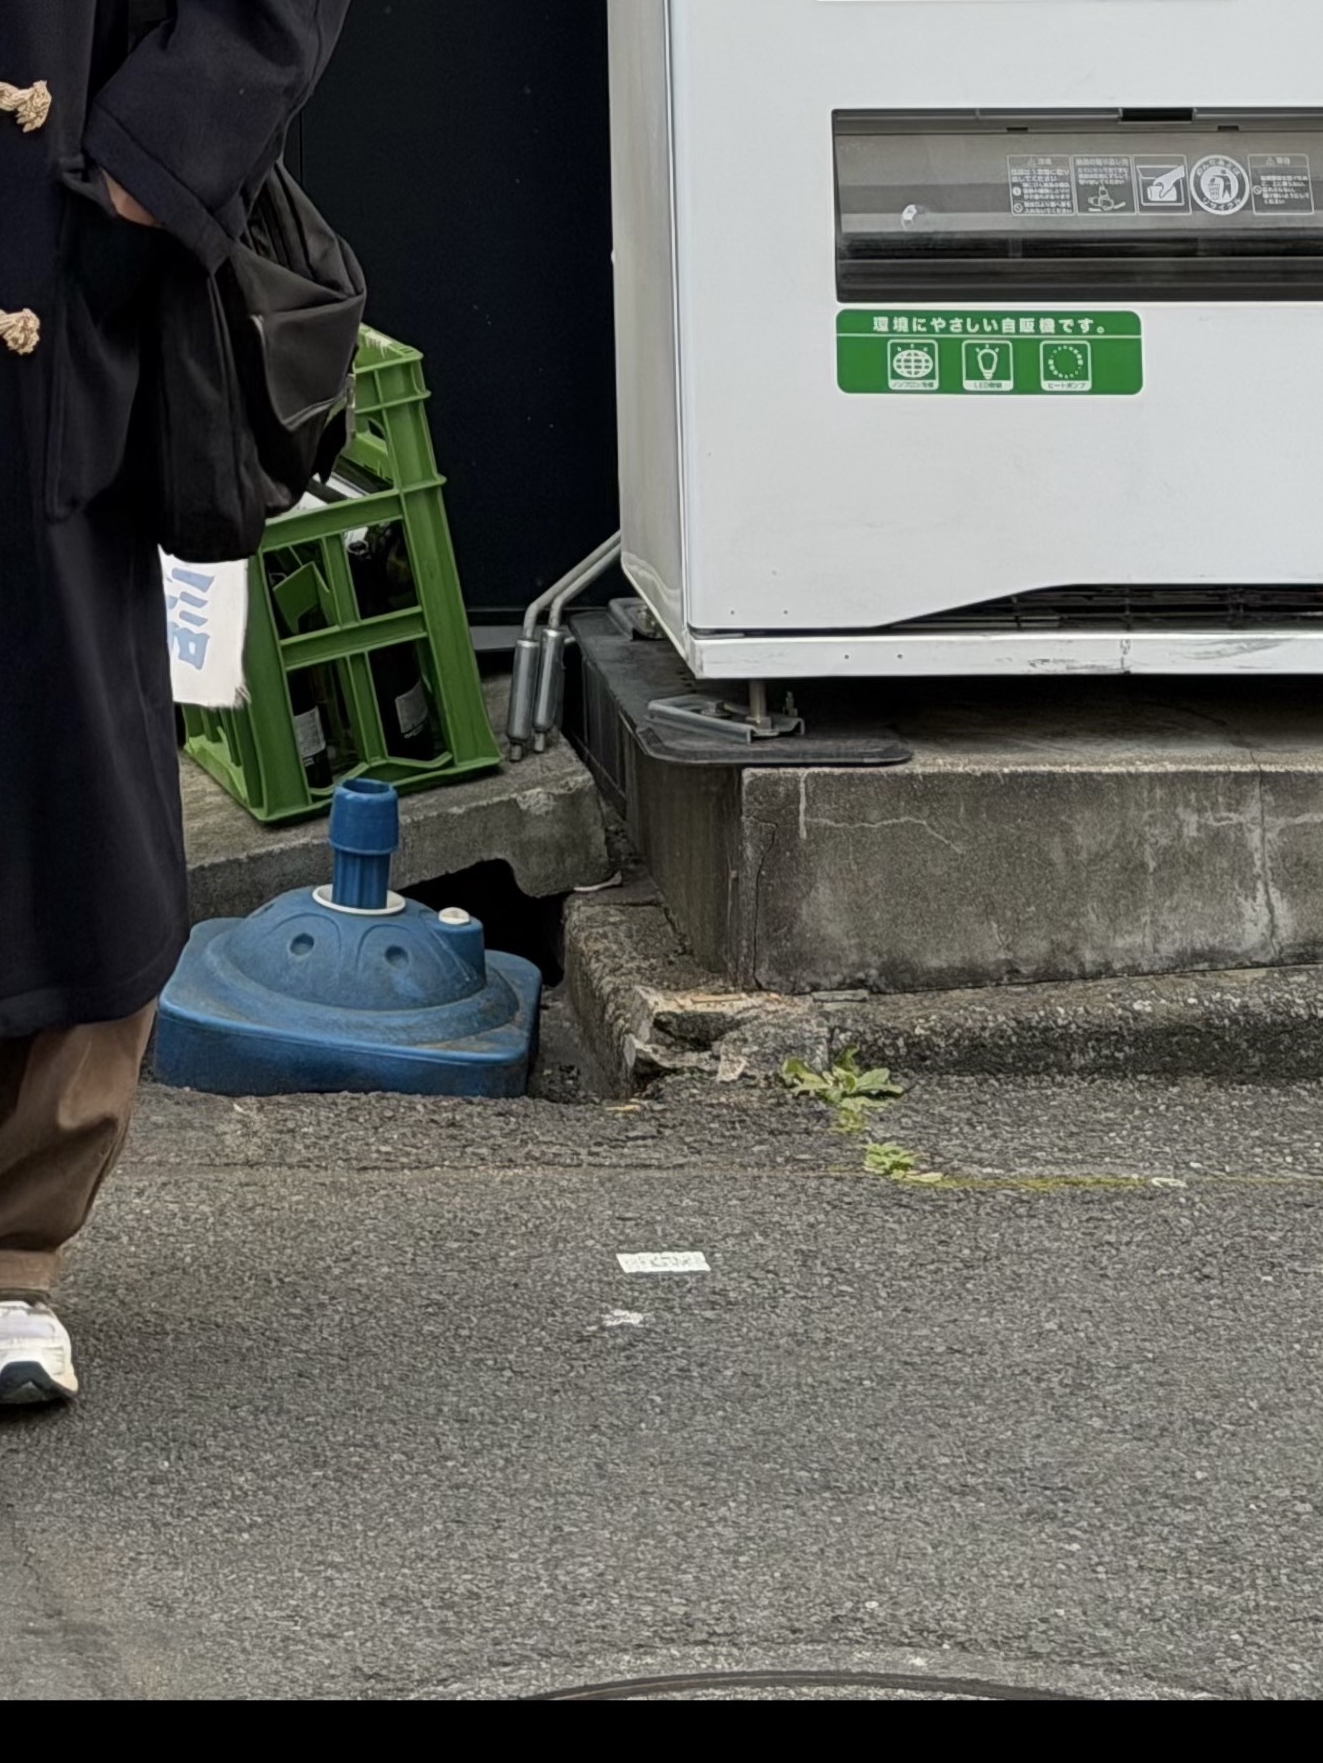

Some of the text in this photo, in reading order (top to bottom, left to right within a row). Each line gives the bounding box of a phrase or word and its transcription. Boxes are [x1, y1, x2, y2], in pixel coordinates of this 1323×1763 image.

[873, 315, 1105, 335] 環境にやさしい自販機です。
